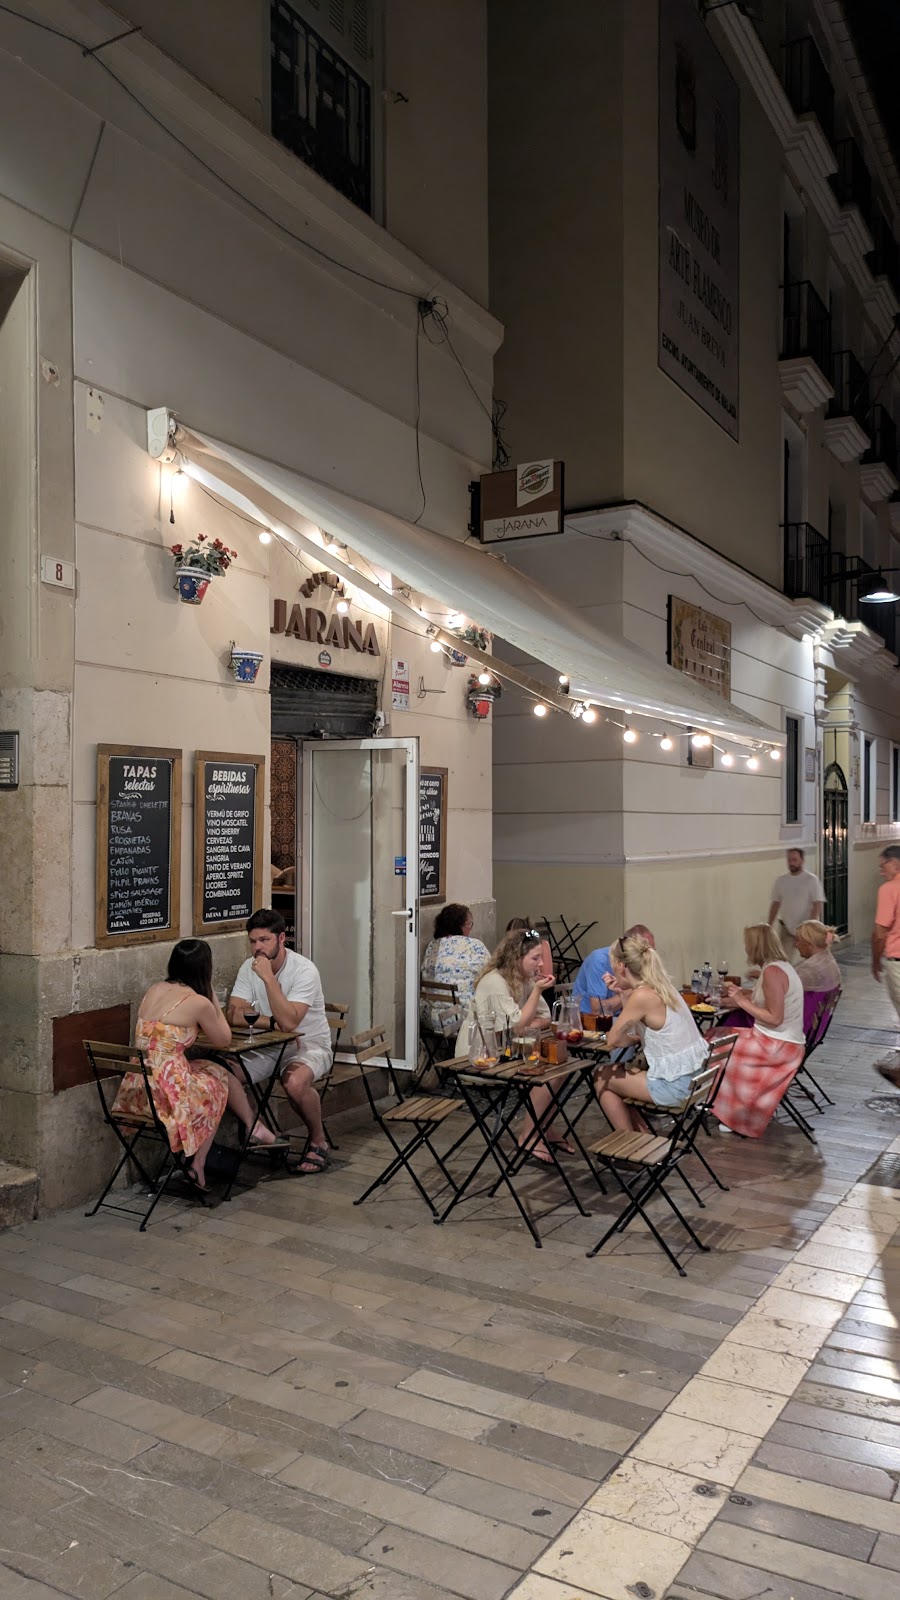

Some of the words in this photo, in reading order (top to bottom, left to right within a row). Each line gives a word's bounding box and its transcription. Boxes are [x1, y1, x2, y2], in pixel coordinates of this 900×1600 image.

[669, 234, 689, 286] ARTE
[693, 259, 731, 335] FLAMENCO
[679, 300, 699, 336] JUAN
[701, 326, 726, 368] BREVA
[520, 478, 531, 488] San
[531, 467, 549, 482] Miguel
[56, 563, 63, 581] 8
[270, 599, 380, 656] JARANA
[690, 628, 715, 654] Central
[123, 765, 157, 778] TAPAS
[212, 770, 246, 782] BEBIDAS
[124, 778, 155, 791] selectas
[208, 782, 251, 798] espirituosas
[111, 811, 142, 823] BRAVAS
[111, 825, 132, 834] RUSA
[109, 836, 151, 845] CROQUETAS
[110, 846, 151, 855] EMPANADAS
[206, 872, 226, 880] APEROL
[227, 871, 244, 879] SPRITZ
[205, 881, 227, 889] LICORES
[205, 889, 240, 898] COMBINADOS
